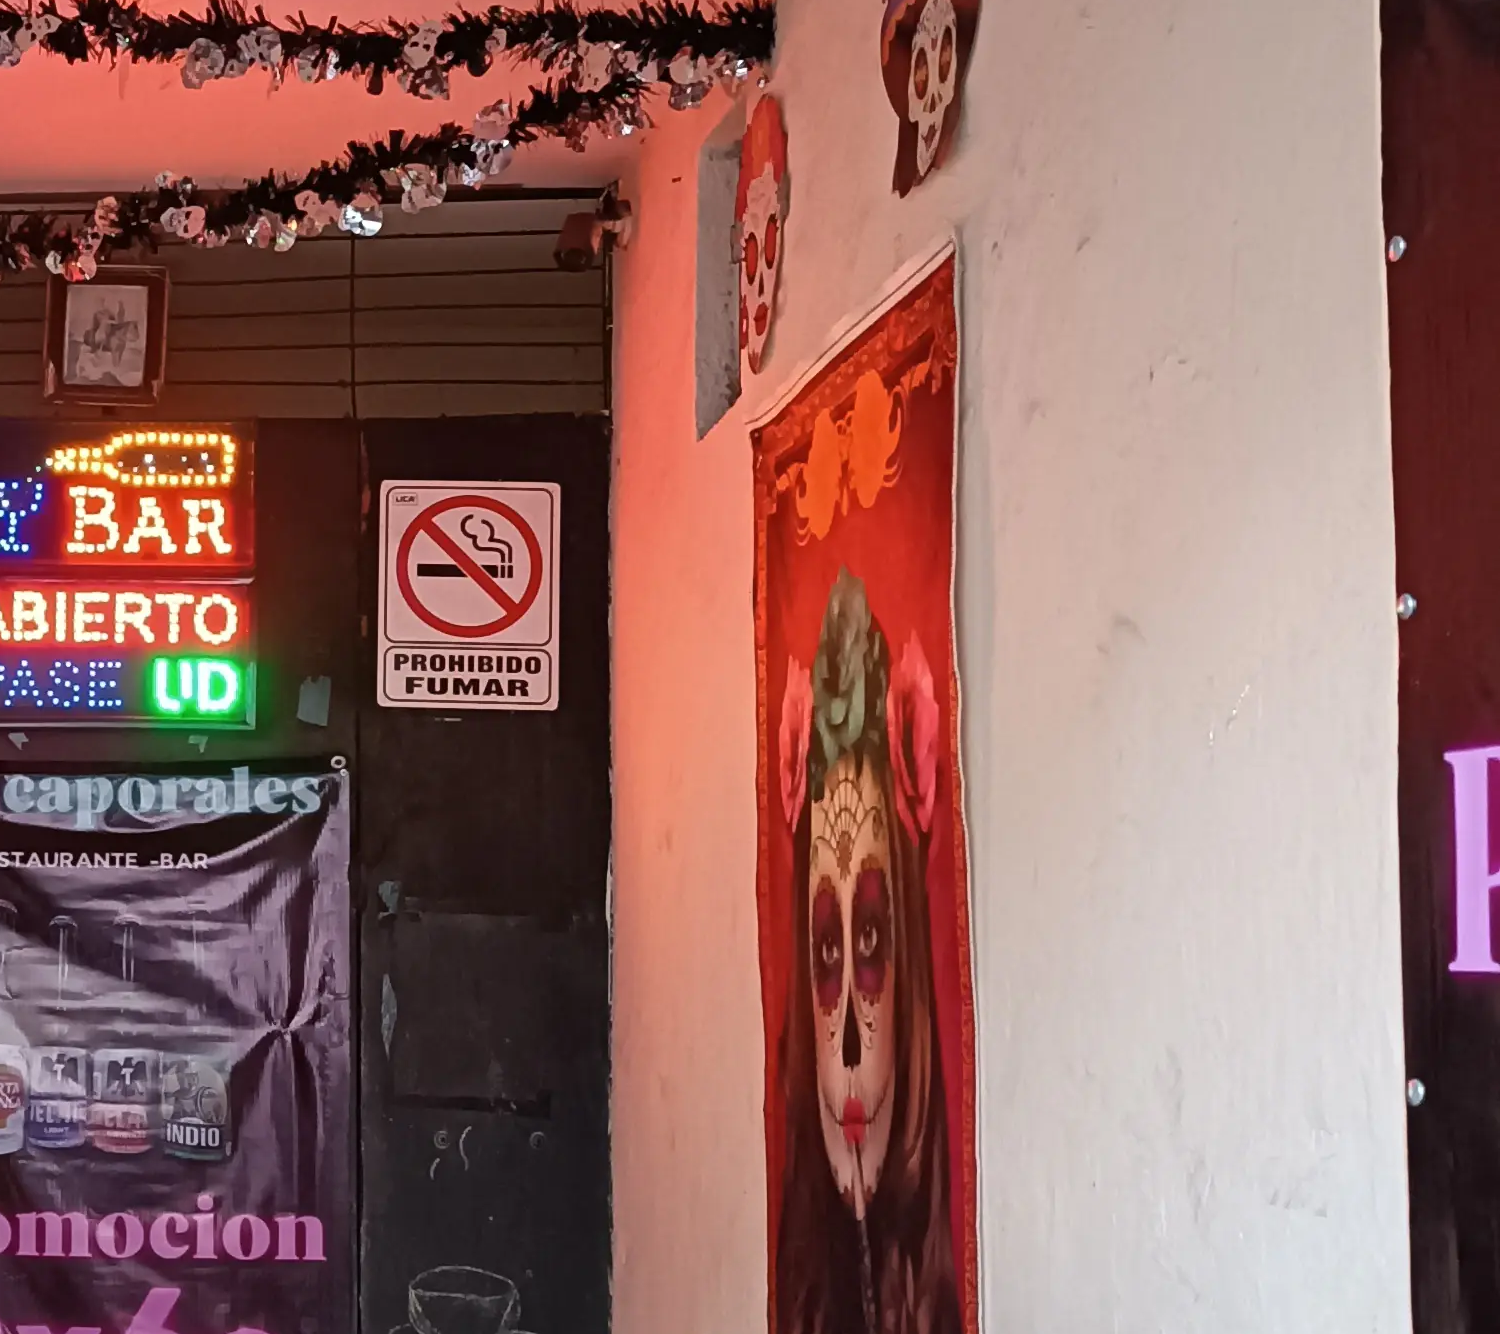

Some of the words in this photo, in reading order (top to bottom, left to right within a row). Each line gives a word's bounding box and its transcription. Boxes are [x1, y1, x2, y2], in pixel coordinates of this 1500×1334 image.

[67, 485, 233, 555] BAR
[393, 653, 542, 675] PROHIBIDO
[404, 676, 530, 697] FUMAR
[2, 765, 322, 831] caporales
[166, 1122, 220, 1147] INDIO
